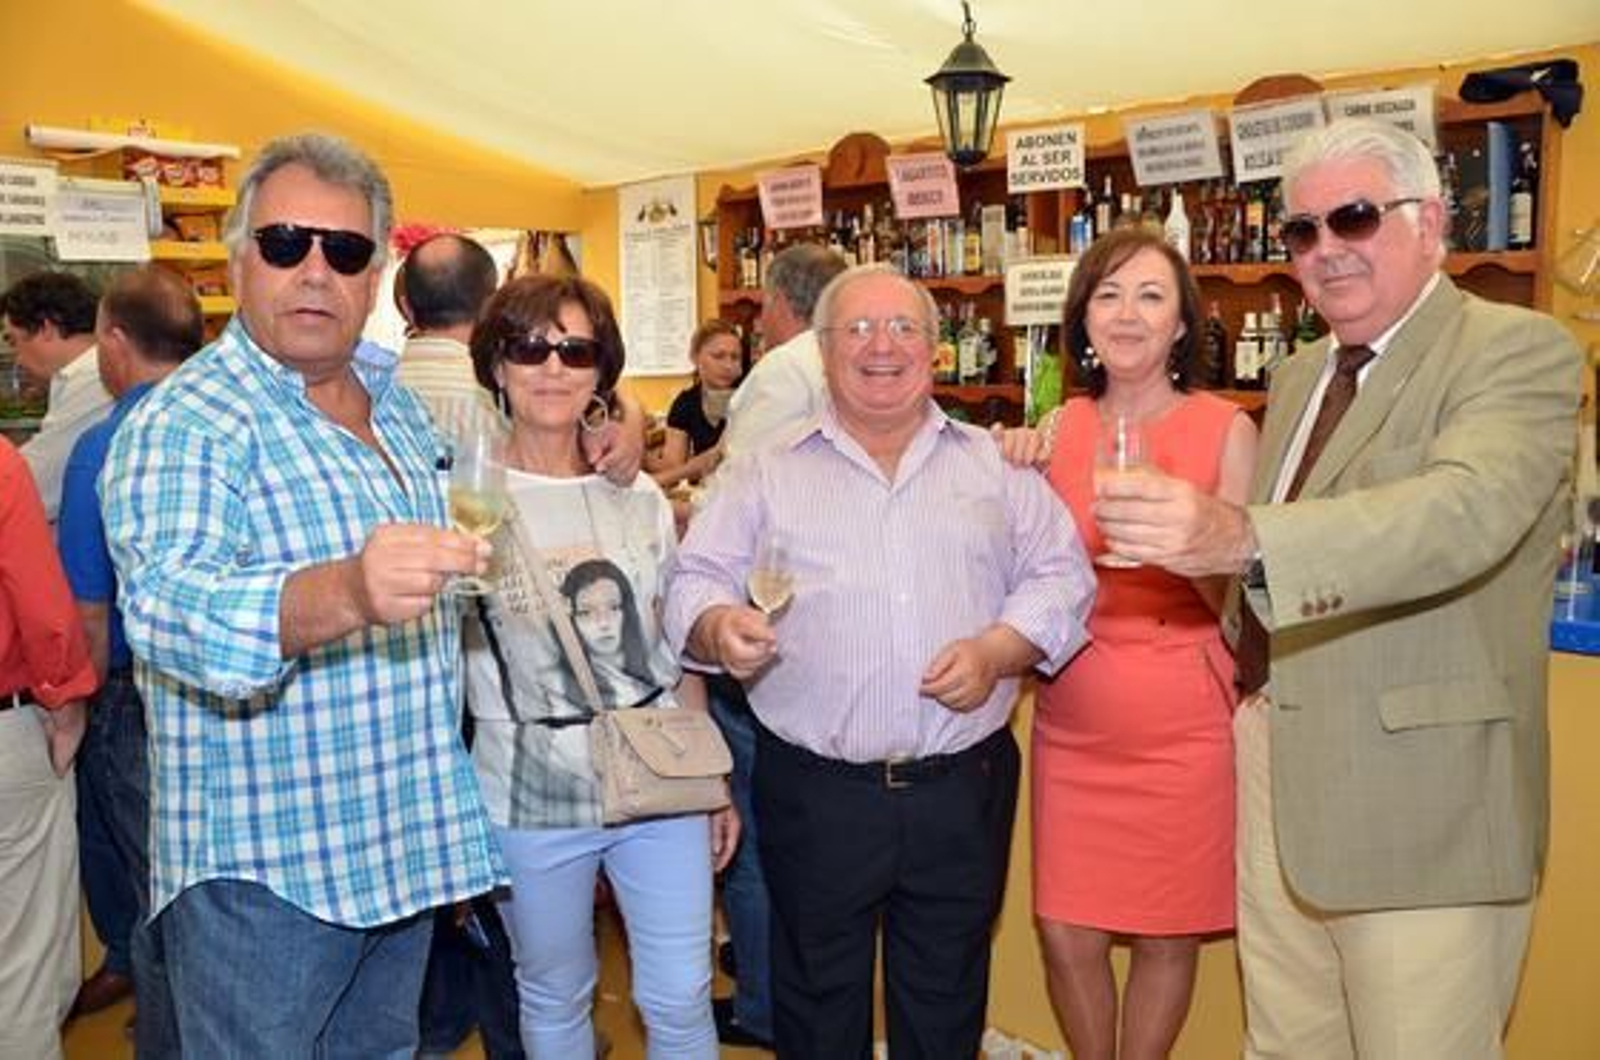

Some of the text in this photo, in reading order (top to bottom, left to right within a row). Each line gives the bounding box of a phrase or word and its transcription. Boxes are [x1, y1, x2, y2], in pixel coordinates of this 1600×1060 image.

[1016, 130, 1077, 150] ABONEN
[1021, 150, 1071, 166] AL SER
[1010, 167, 1080, 185] SERVIDOS
